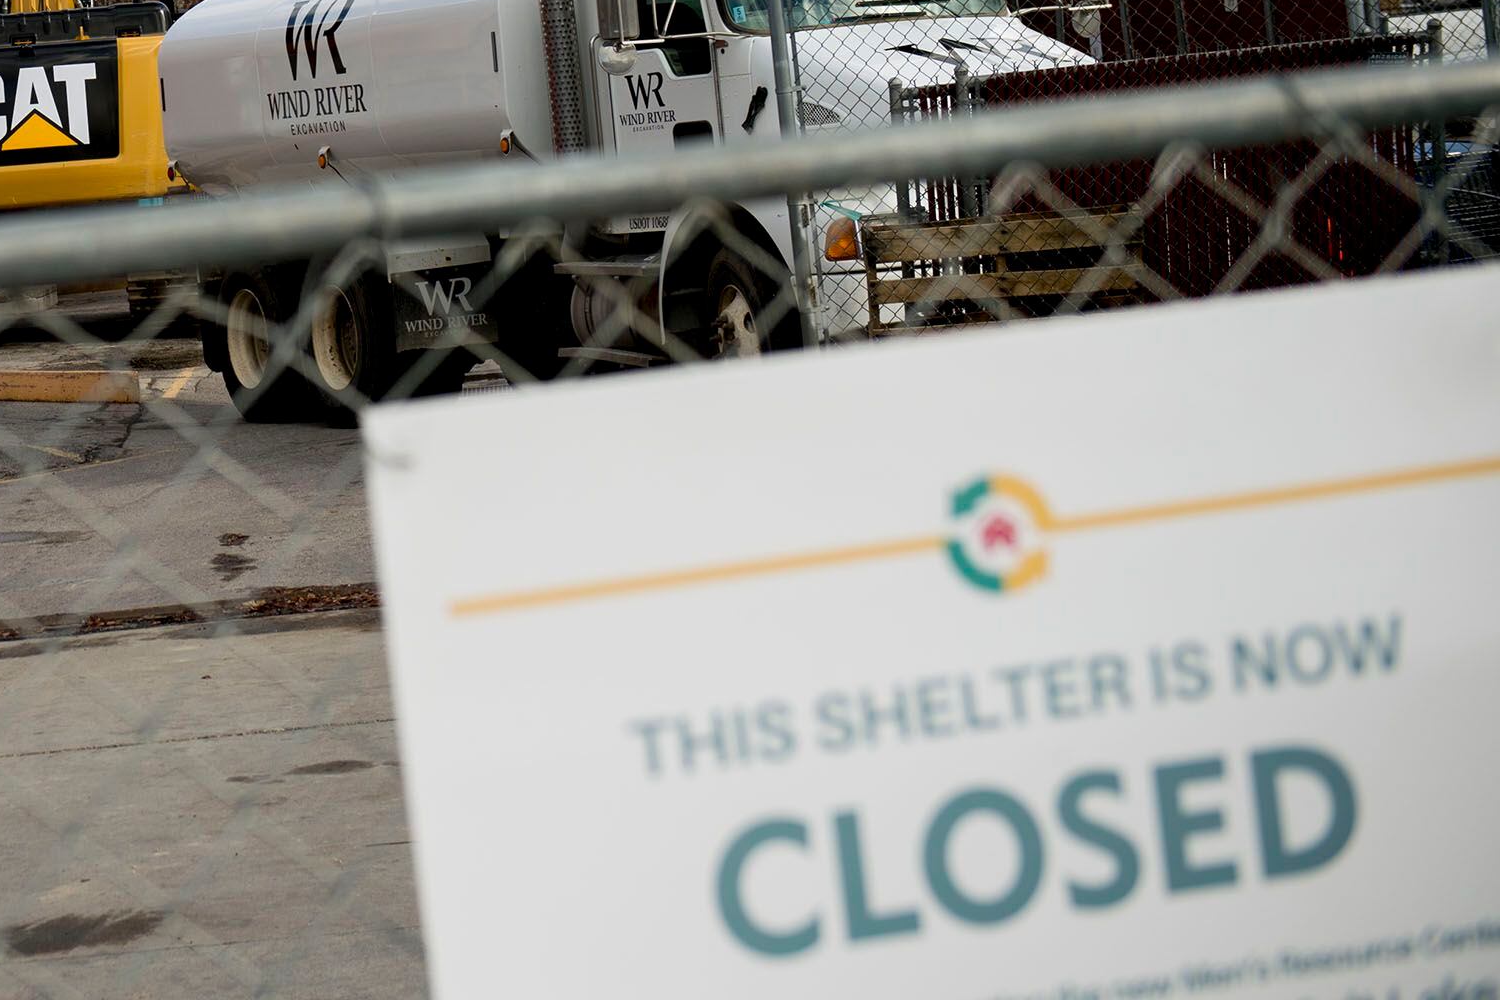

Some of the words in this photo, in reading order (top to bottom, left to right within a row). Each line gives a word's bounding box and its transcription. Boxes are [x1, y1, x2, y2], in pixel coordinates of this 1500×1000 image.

[267, 89, 311, 121] WIND
[314, 83, 368, 117] RIVER
[619, 113, 645, 126] WIND
[647, 109, 677, 124] RIVER
[290, 120, 347, 136] EXCAVATION
[629, 216, 650, 230] USDOT
[404, 318, 443, 333] WIND
[446, 313, 488, 329] RIVER
[631, 699, 798, 778] THIS
[813, 653, 1134, 753] SHELTER
[1150, 636, 1212, 706] IS
[1231, 613, 1403, 692] NOW
[715, 744, 1358, 958] CLOSED
